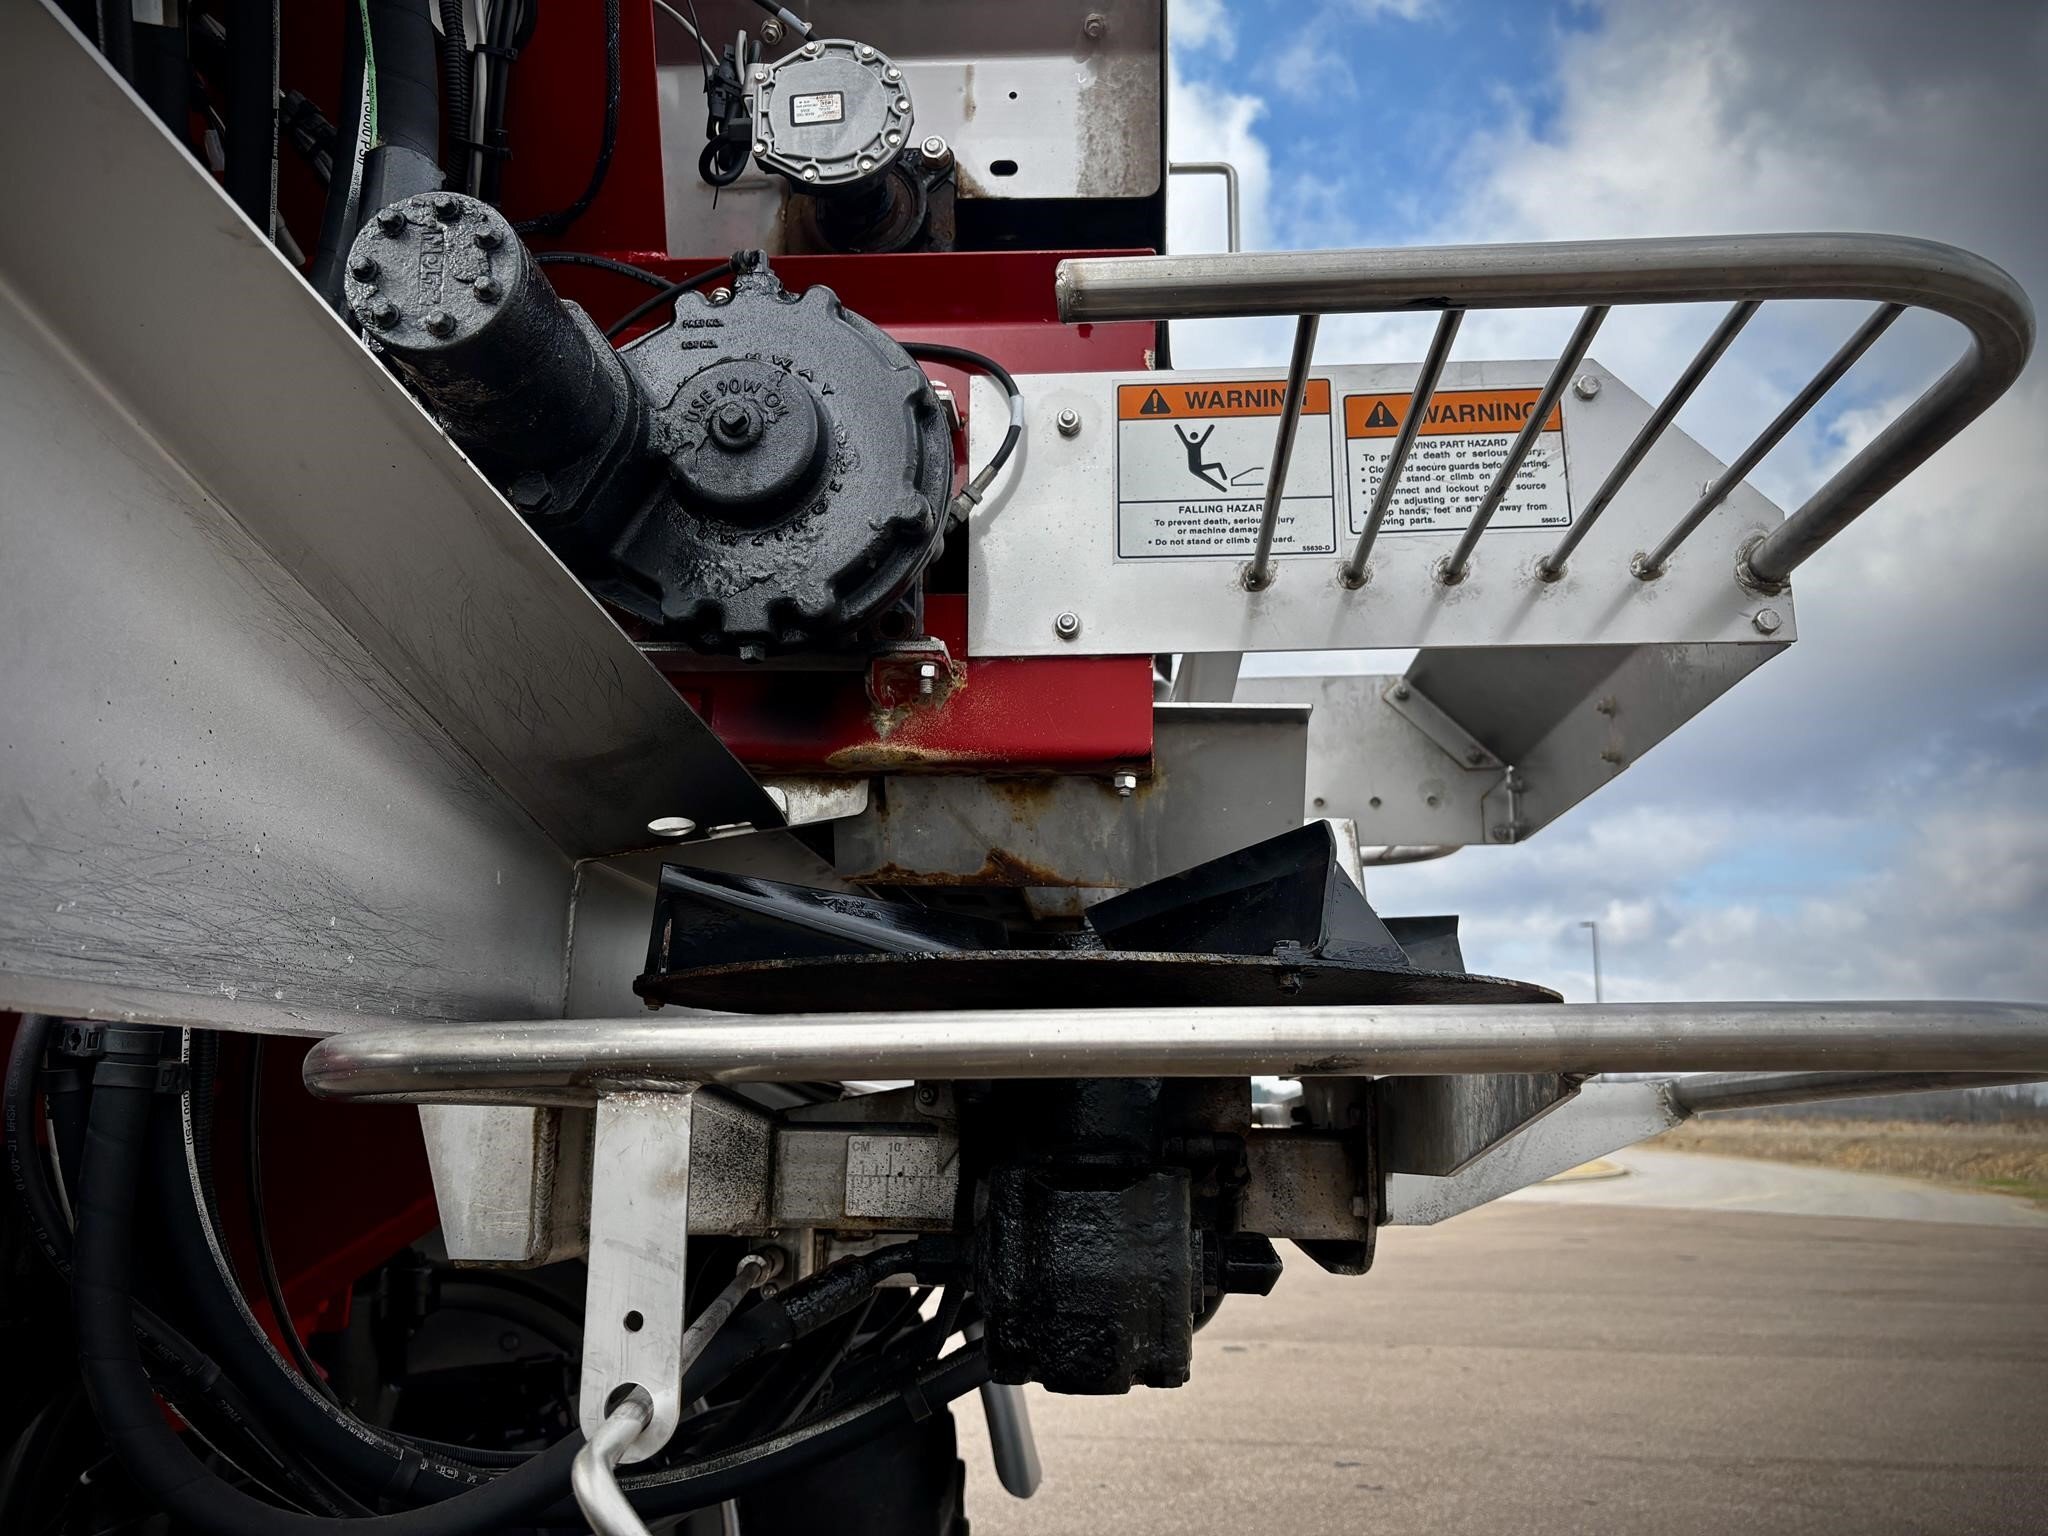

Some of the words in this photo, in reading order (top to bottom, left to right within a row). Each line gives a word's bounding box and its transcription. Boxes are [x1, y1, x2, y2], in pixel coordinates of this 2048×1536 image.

[682, 319, 705, 328] PART
[685, 390, 715, 422] USE
[717, 378, 762, 396] 90W
[1185, 389, 1307, 410] WARNIN
[1412, 441, 1437, 449] VING
[1440, 440, 1465, 448] PART
[1468, 439, 1508, 447] HAZARD
[1363, 454, 1375, 462] To
[1381, 453, 1417, 463] prnt
[1423, 451, 1450, 459] death
[1473, 449, 1508, 457] serious
[1416, 464, 1446, 472] secure
[1449, 462, 1480, 472] guards
[1482, 461, 1502, 469] befo
[1522, 460, 1550, 469] arting.
[1370, 476, 1381, 484] Do
[1406, 474, 1431, 482] stand
[1450, 472, 1474, 481] climb
[1370, 487, 1420, 495] Dnnect
[1446, 484, 1479, 492] lockout
[1404, 496, 1445, 506] adjusting
[1178, 505, 1223, 514] FALLING
[1226, 504, 1263, 513] HAZAR
[1399, 507, 1429, 515] hands,
[1434, 506, 1451, 514] feet
[1456, 505, 1472, 513] and
[1499, 504, 1522, 512] away
[1168, 518, 1201, 527] prevent
[1278, 516, 1295, 524] jury
[1380, 518, 1405, 526] oving
[1410, 517, 1435, 526] parts.
[1229, 526, 1258, 534] damag
[1187, 537, 1211, 545] stand
[852, 1141, 870, 1152] CM
[889, 1142, 901, 1152] 10
